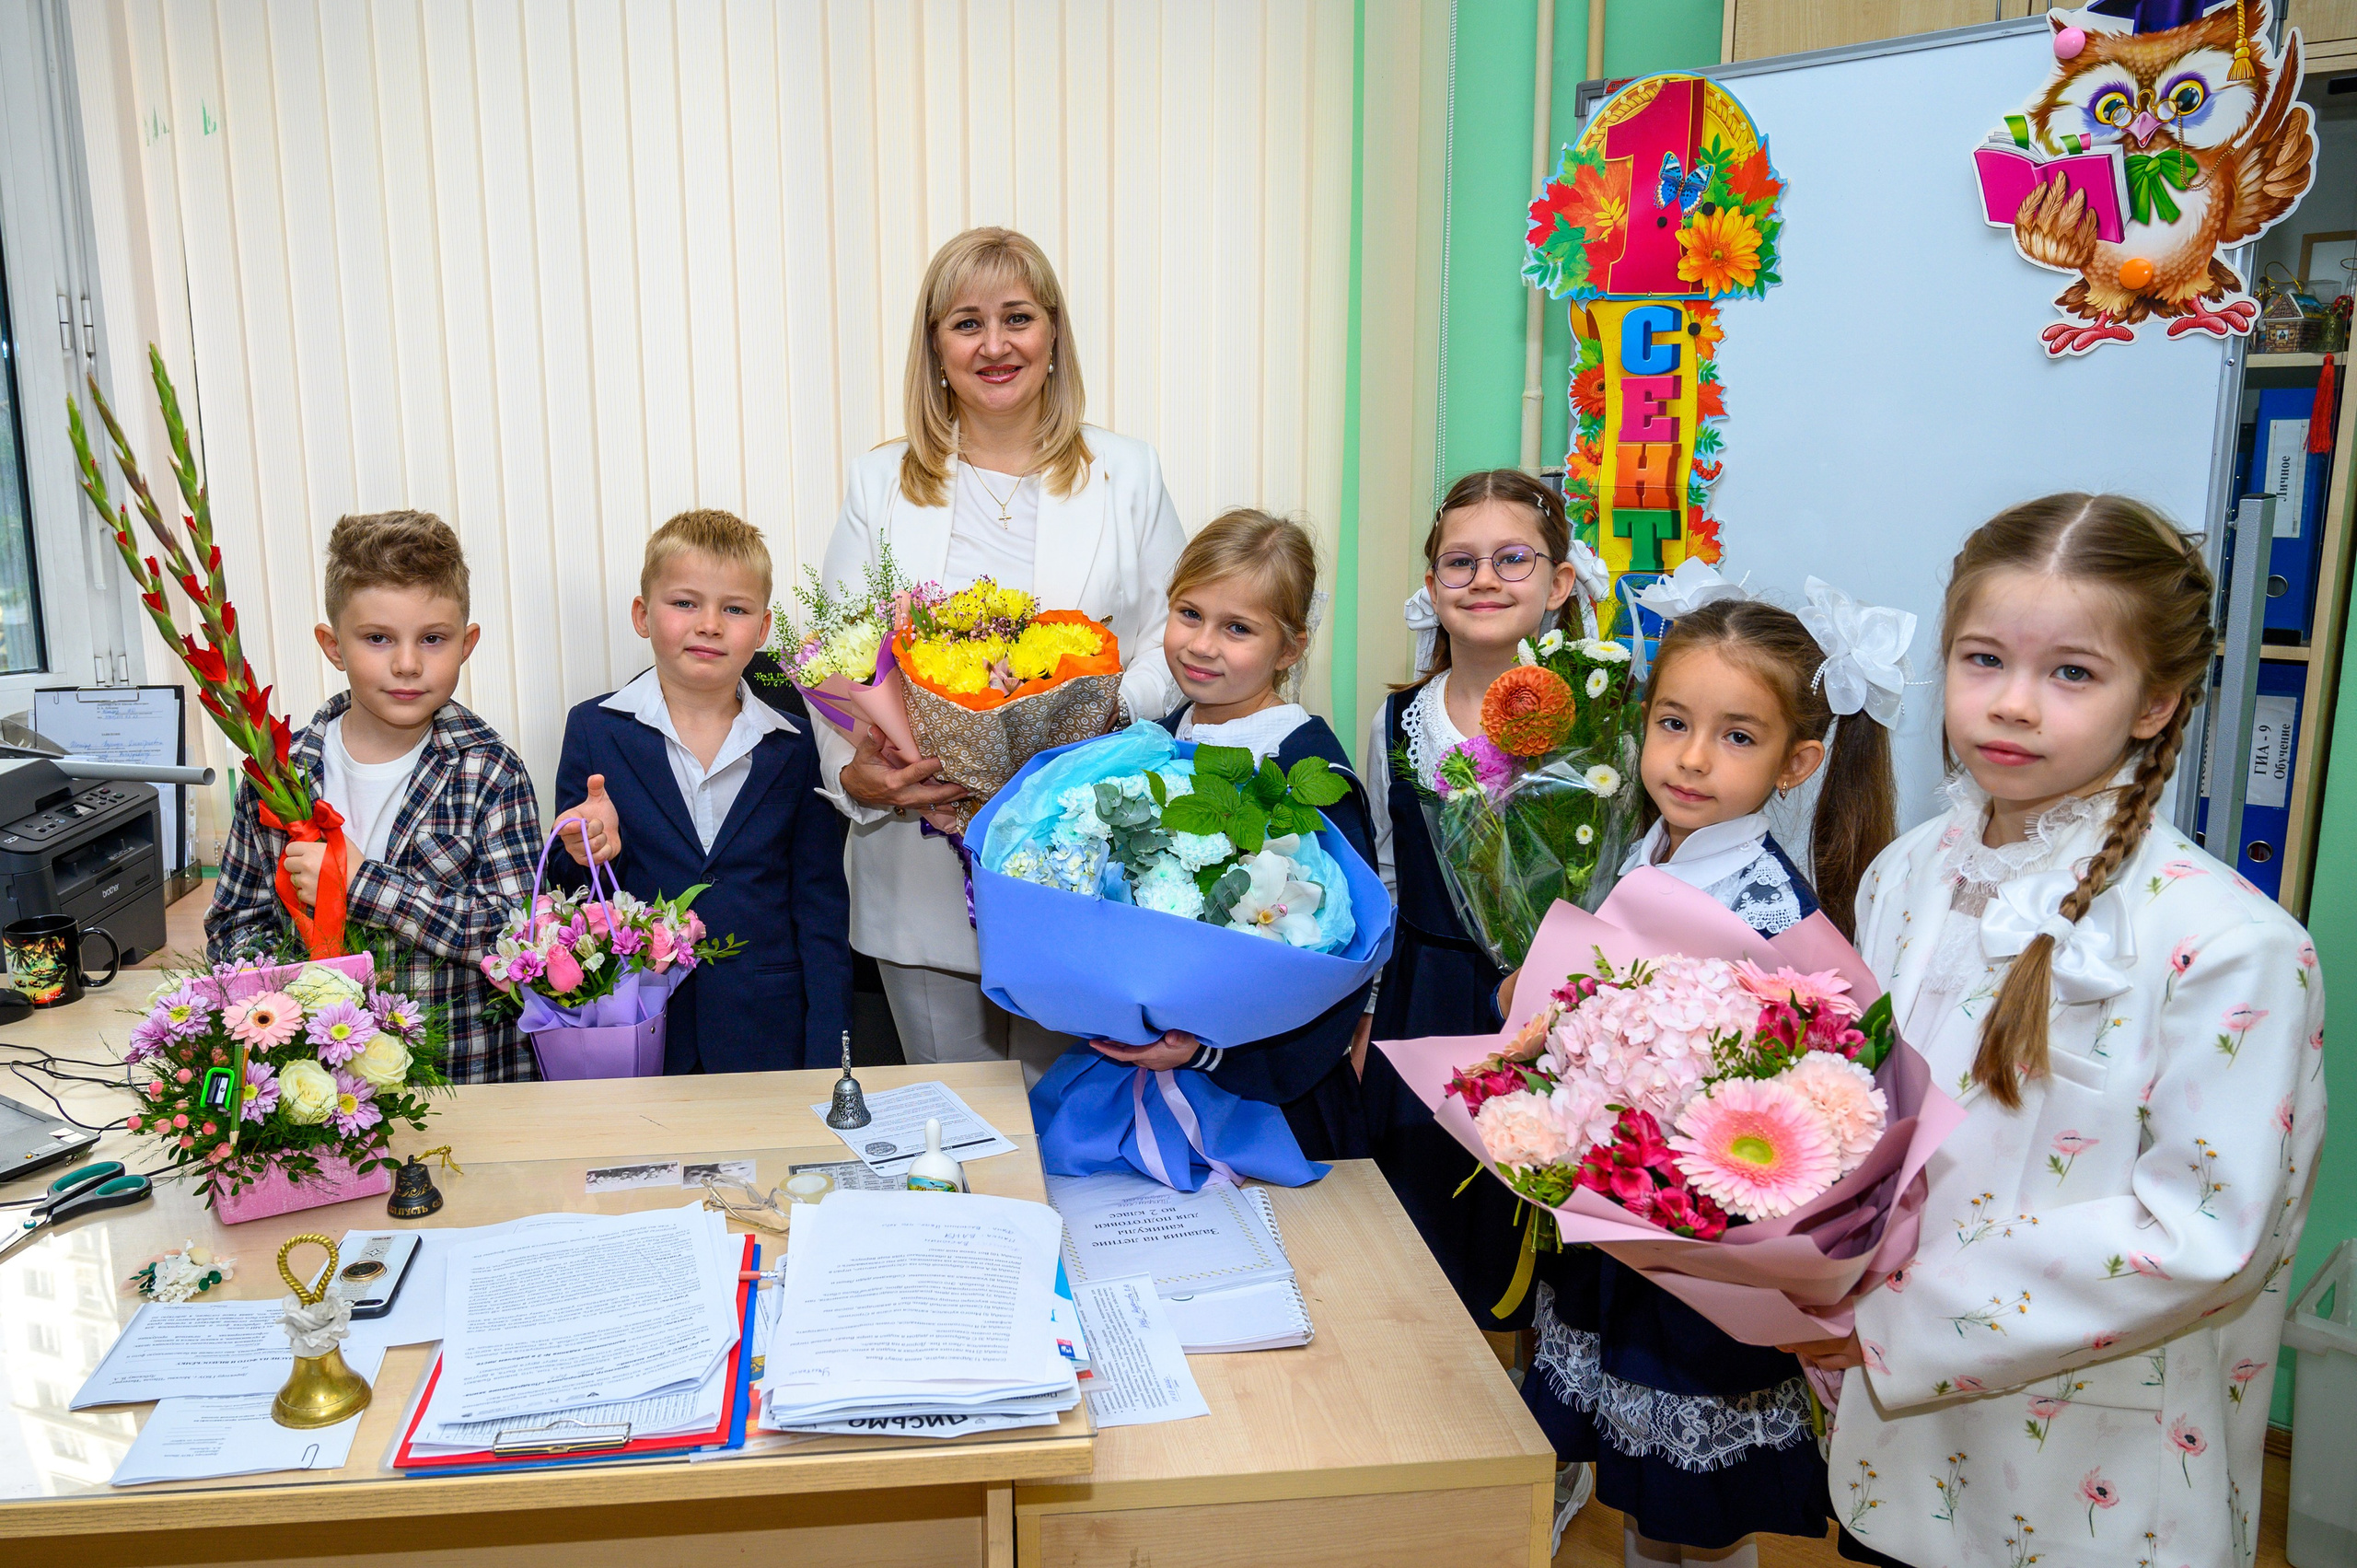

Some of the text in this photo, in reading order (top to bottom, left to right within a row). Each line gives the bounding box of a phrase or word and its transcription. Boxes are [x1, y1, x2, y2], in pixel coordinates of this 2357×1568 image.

[1605, 77, 1706, 295] 1
[2276, 455, 2291, 503] Личное
[2258, 725, 2271, 734] 9
[2274, 724, 2292, 780] Обучение
[2254, 745, 2270, 776] ГИА
[102, 883, 120, 898] brother
[1094, 1213, 1198, 1230] для подготовки
[1109, 1210, 1145, 1220] класс
[1118, 1224, 1184, 1236] каникулы
[1163, 1228, 1219, 1241] Задания
[1092, 1237, 1138, 1248] летние
[847, 1414, 969, 1430] ПИСЬМО
